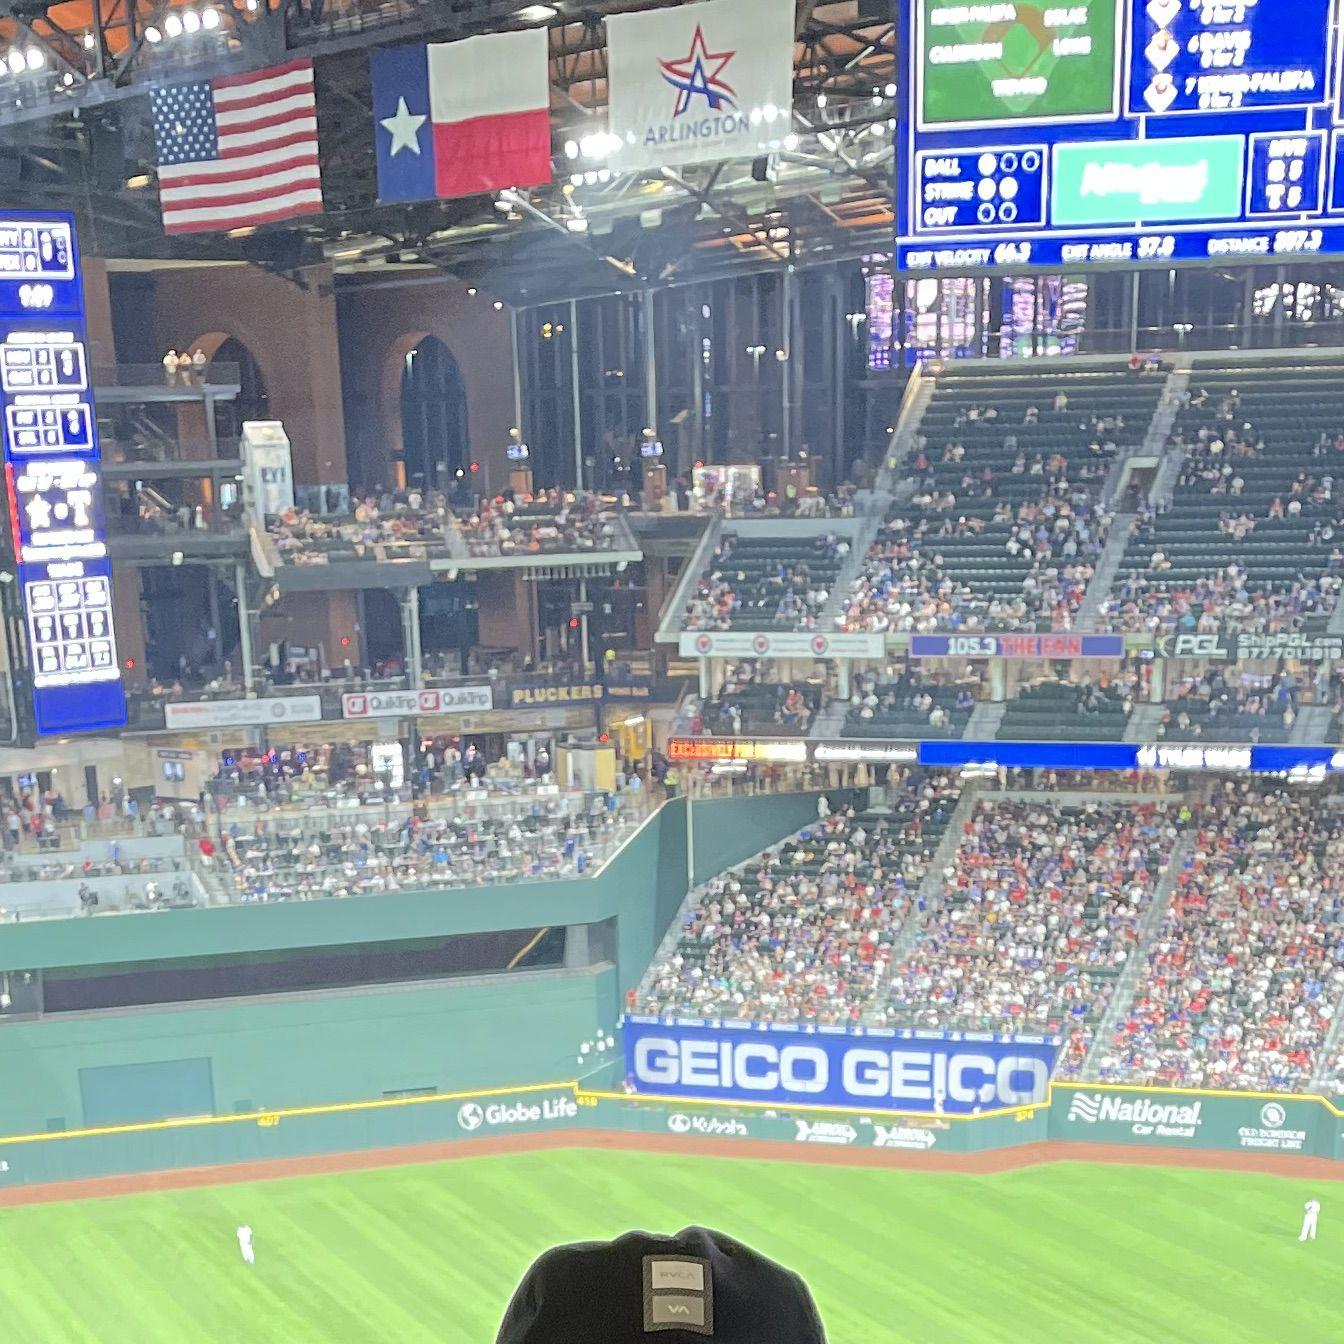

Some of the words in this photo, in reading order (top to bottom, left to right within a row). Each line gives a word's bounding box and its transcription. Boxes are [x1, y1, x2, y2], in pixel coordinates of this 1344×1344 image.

[643, 113, 750, 146] ARLINGTON
[947, 636, 997, 656] 105.3
[999, 636, 1037, 656] THE
[1175, 634, 1229, 658] PGL
[513, 684, 603, 704] PLUCKERS
[635, 1036, 828, 1094] GEICO
[843, 1043, 1051, 1106] GEICO
[487, 1102, 541, 1126] Globe
[543, 1097, 578, 1119] Life
[1099, 1097, 1202, 1126] National
[1132, 1124, 1153, 1136] Car
[659, 1271, 696, 1281] RVCA
